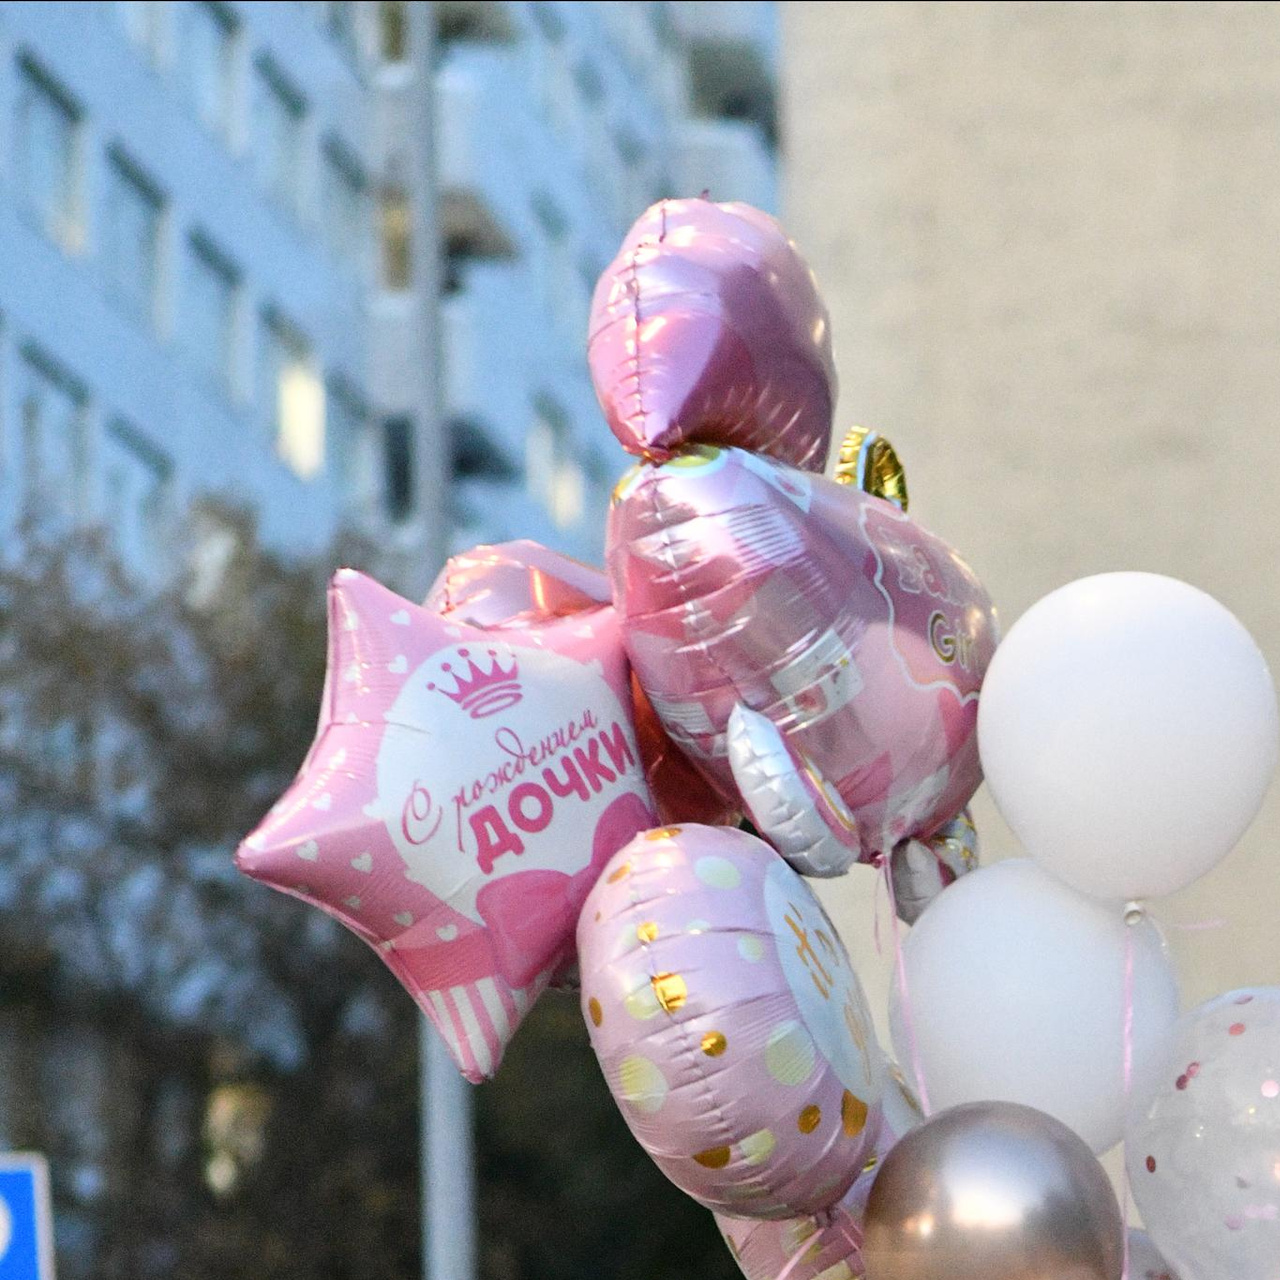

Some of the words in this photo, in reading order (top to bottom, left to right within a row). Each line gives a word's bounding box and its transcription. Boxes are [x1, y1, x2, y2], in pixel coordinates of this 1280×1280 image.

[401, 779, 443, 846] С
[452, 709, 598, 853] рождением
[468, 721, 635, 875] ДОЧКИ
